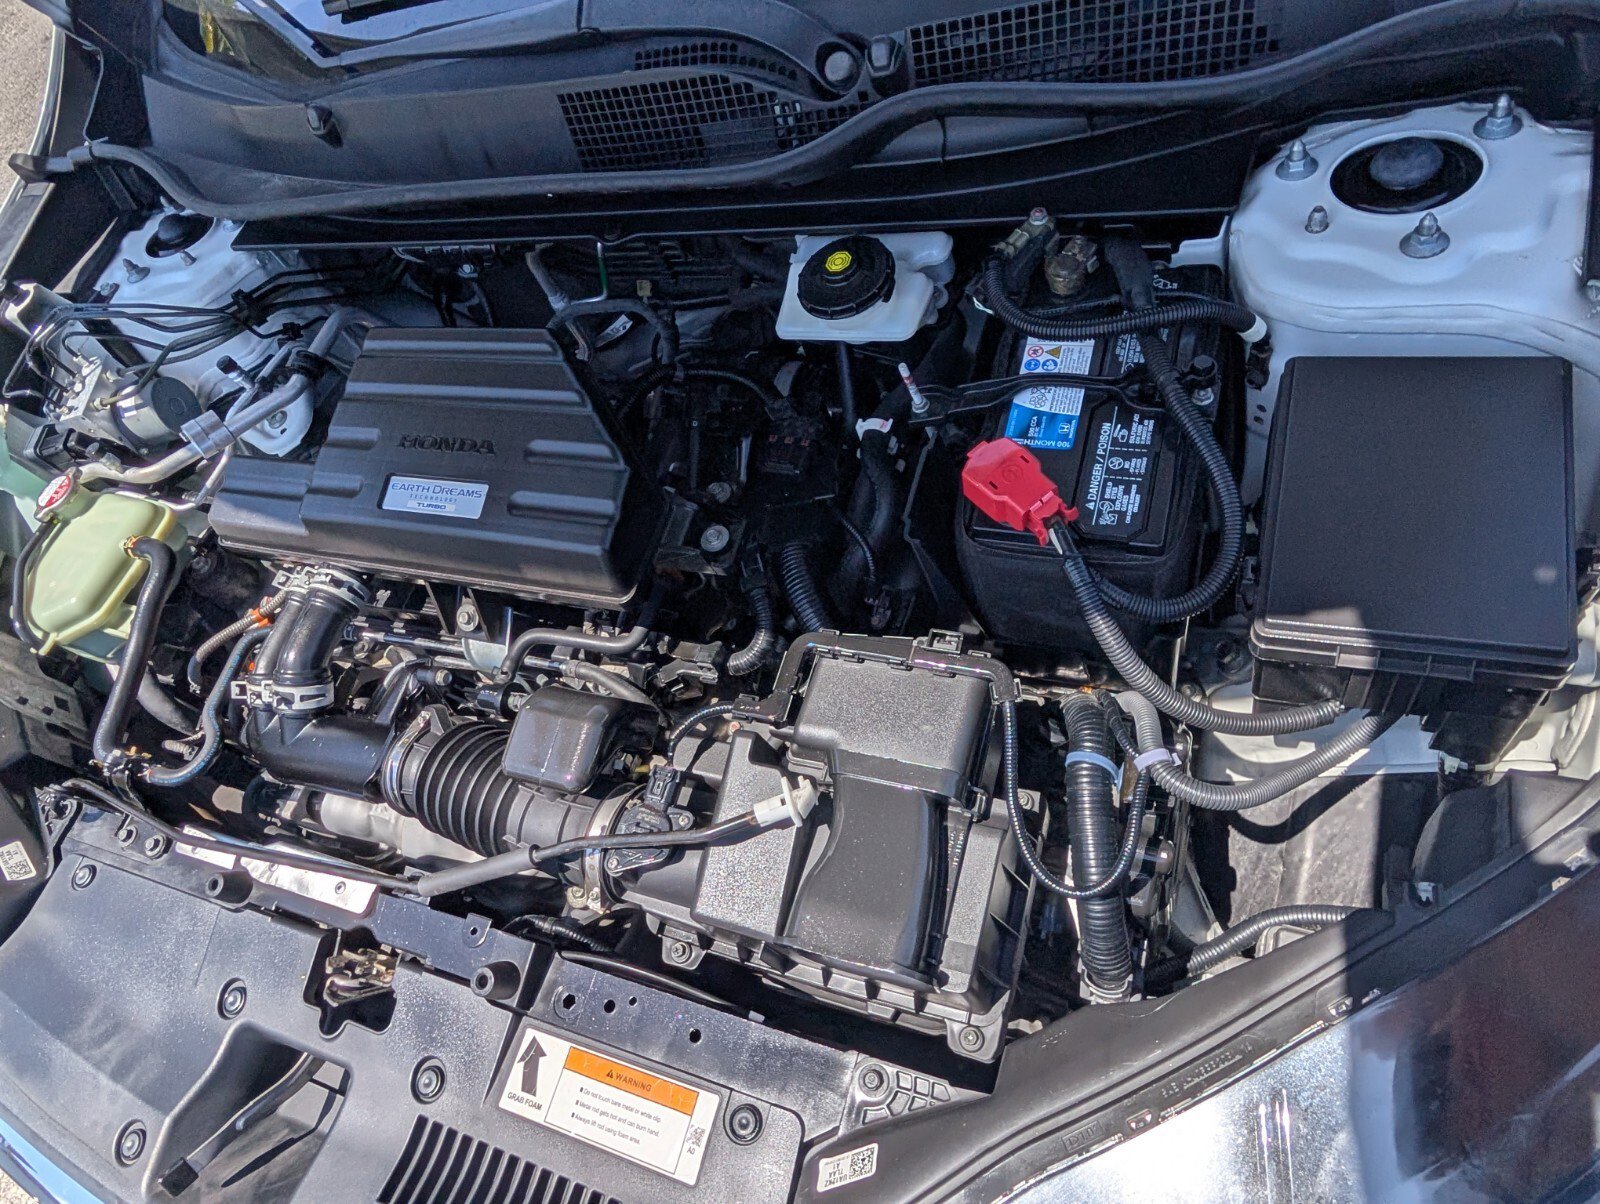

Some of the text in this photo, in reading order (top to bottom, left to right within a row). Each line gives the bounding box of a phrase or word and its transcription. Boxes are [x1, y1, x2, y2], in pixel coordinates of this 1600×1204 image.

[399, 434, 495, 455] HONDA
[1087, 463, 1103, 501] DANGER
[1097, 422, 1111, 455] POISON
[391, 482, 483, 498] EARTH DREAMS
[409, 493, 457, 503] TECHNOLOGY
[416, 502, 446, 510] TURBO
[1121, 494, 1129, 511] GASES
[615, 1072, 652, 1092] WARNING
[507, 1091, 543, 1111] GRAB FOAM
[583, 1088, 590, 1096] Do
[598, 1093, 611, 1103] touch
[611, 1097, 621, 1107] bare
[622, 1101, 634, 1112] metal
[640, 1108, 653, 1119] white
[575, 1113, 590, 1127] Always
[597, 1122, 605, 1131] rod
[605, 1125, 617, 1137] using
[617, 1129, 629, 1140] foam
[592, 1106, 600, 1114] rod
[599, 1108, 610, 1118] gets
[618, 1116, 627, 1124] and
[627, 1119, 635, 1127] can
[636, 1122, 647, 1132] burn
